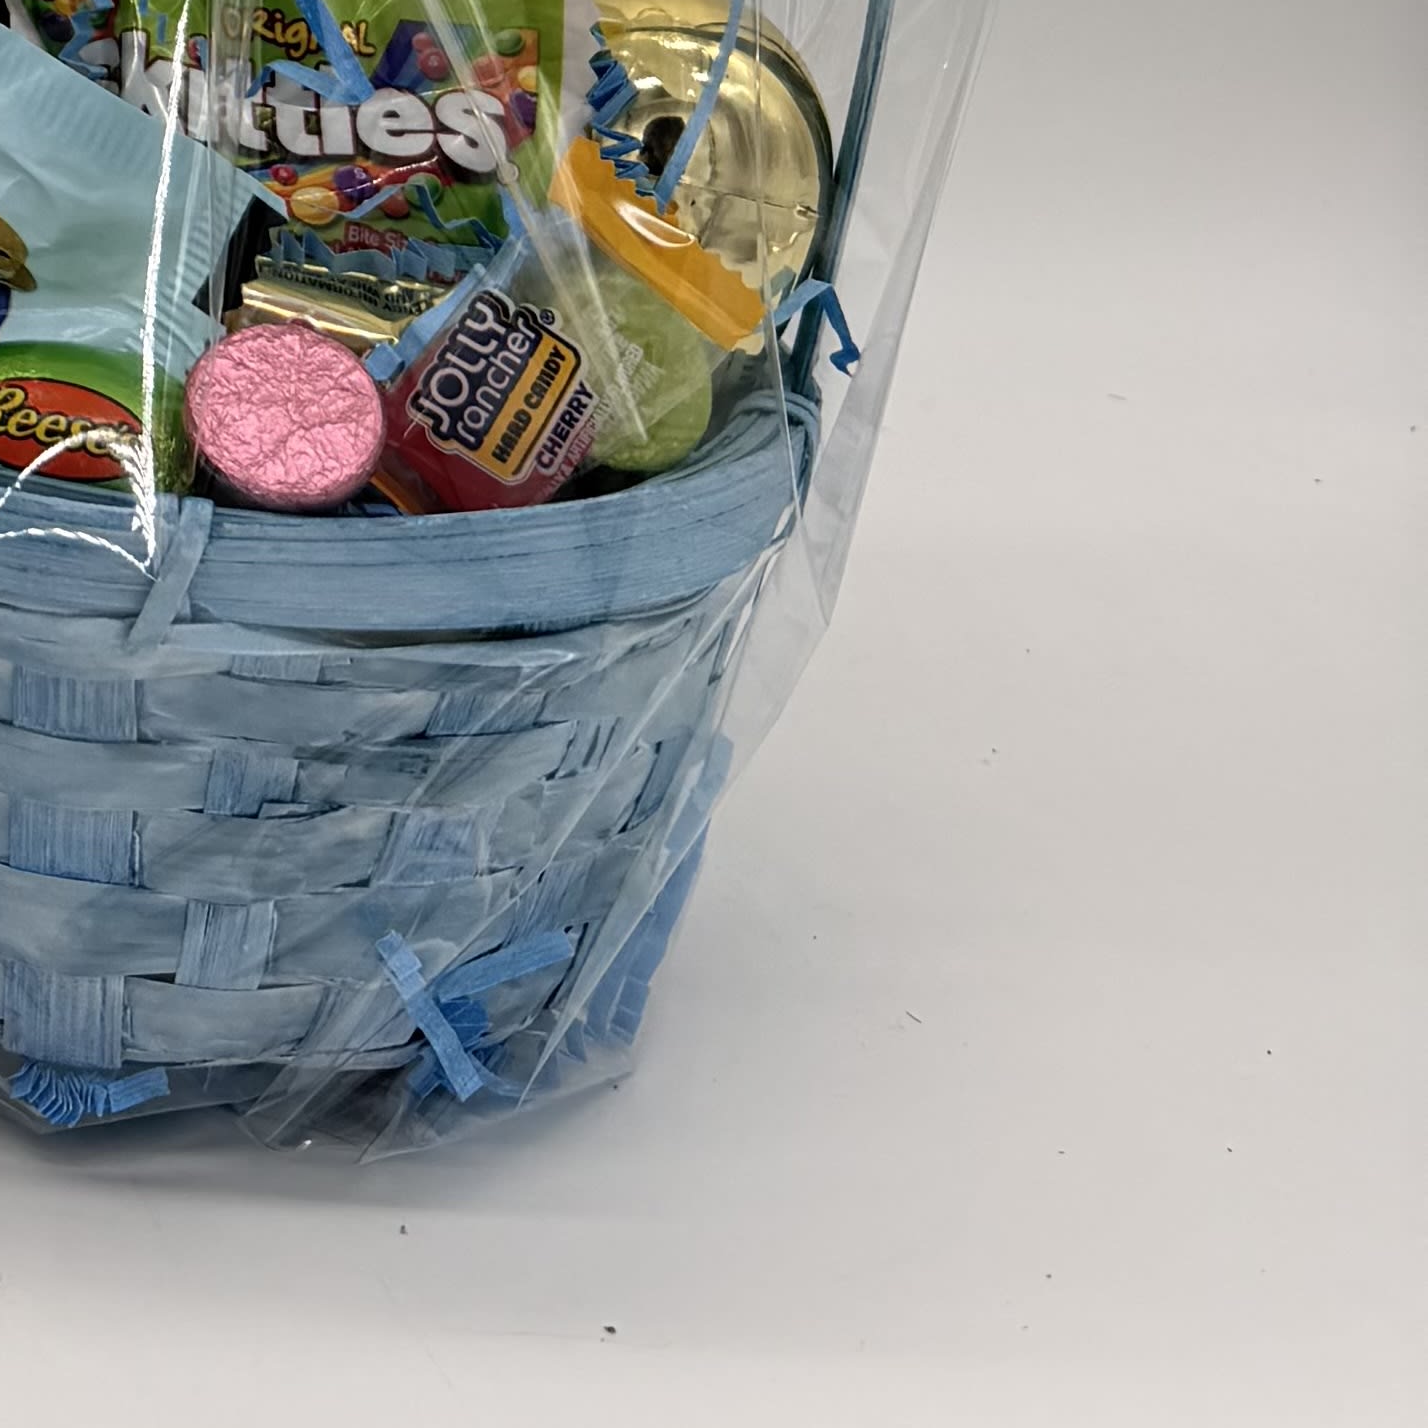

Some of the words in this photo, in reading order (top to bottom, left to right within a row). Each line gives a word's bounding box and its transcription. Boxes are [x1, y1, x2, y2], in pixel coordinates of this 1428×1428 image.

[347, 225, 381, 244] Bite
[416, 300, 507, 433] JOLLY
[455, 318, 536, 443] rancher
[491, 405, 533, 465] HARD
[523, 345, 567, 410] CANDY
[536, 380, 595, 469] CHERRY
